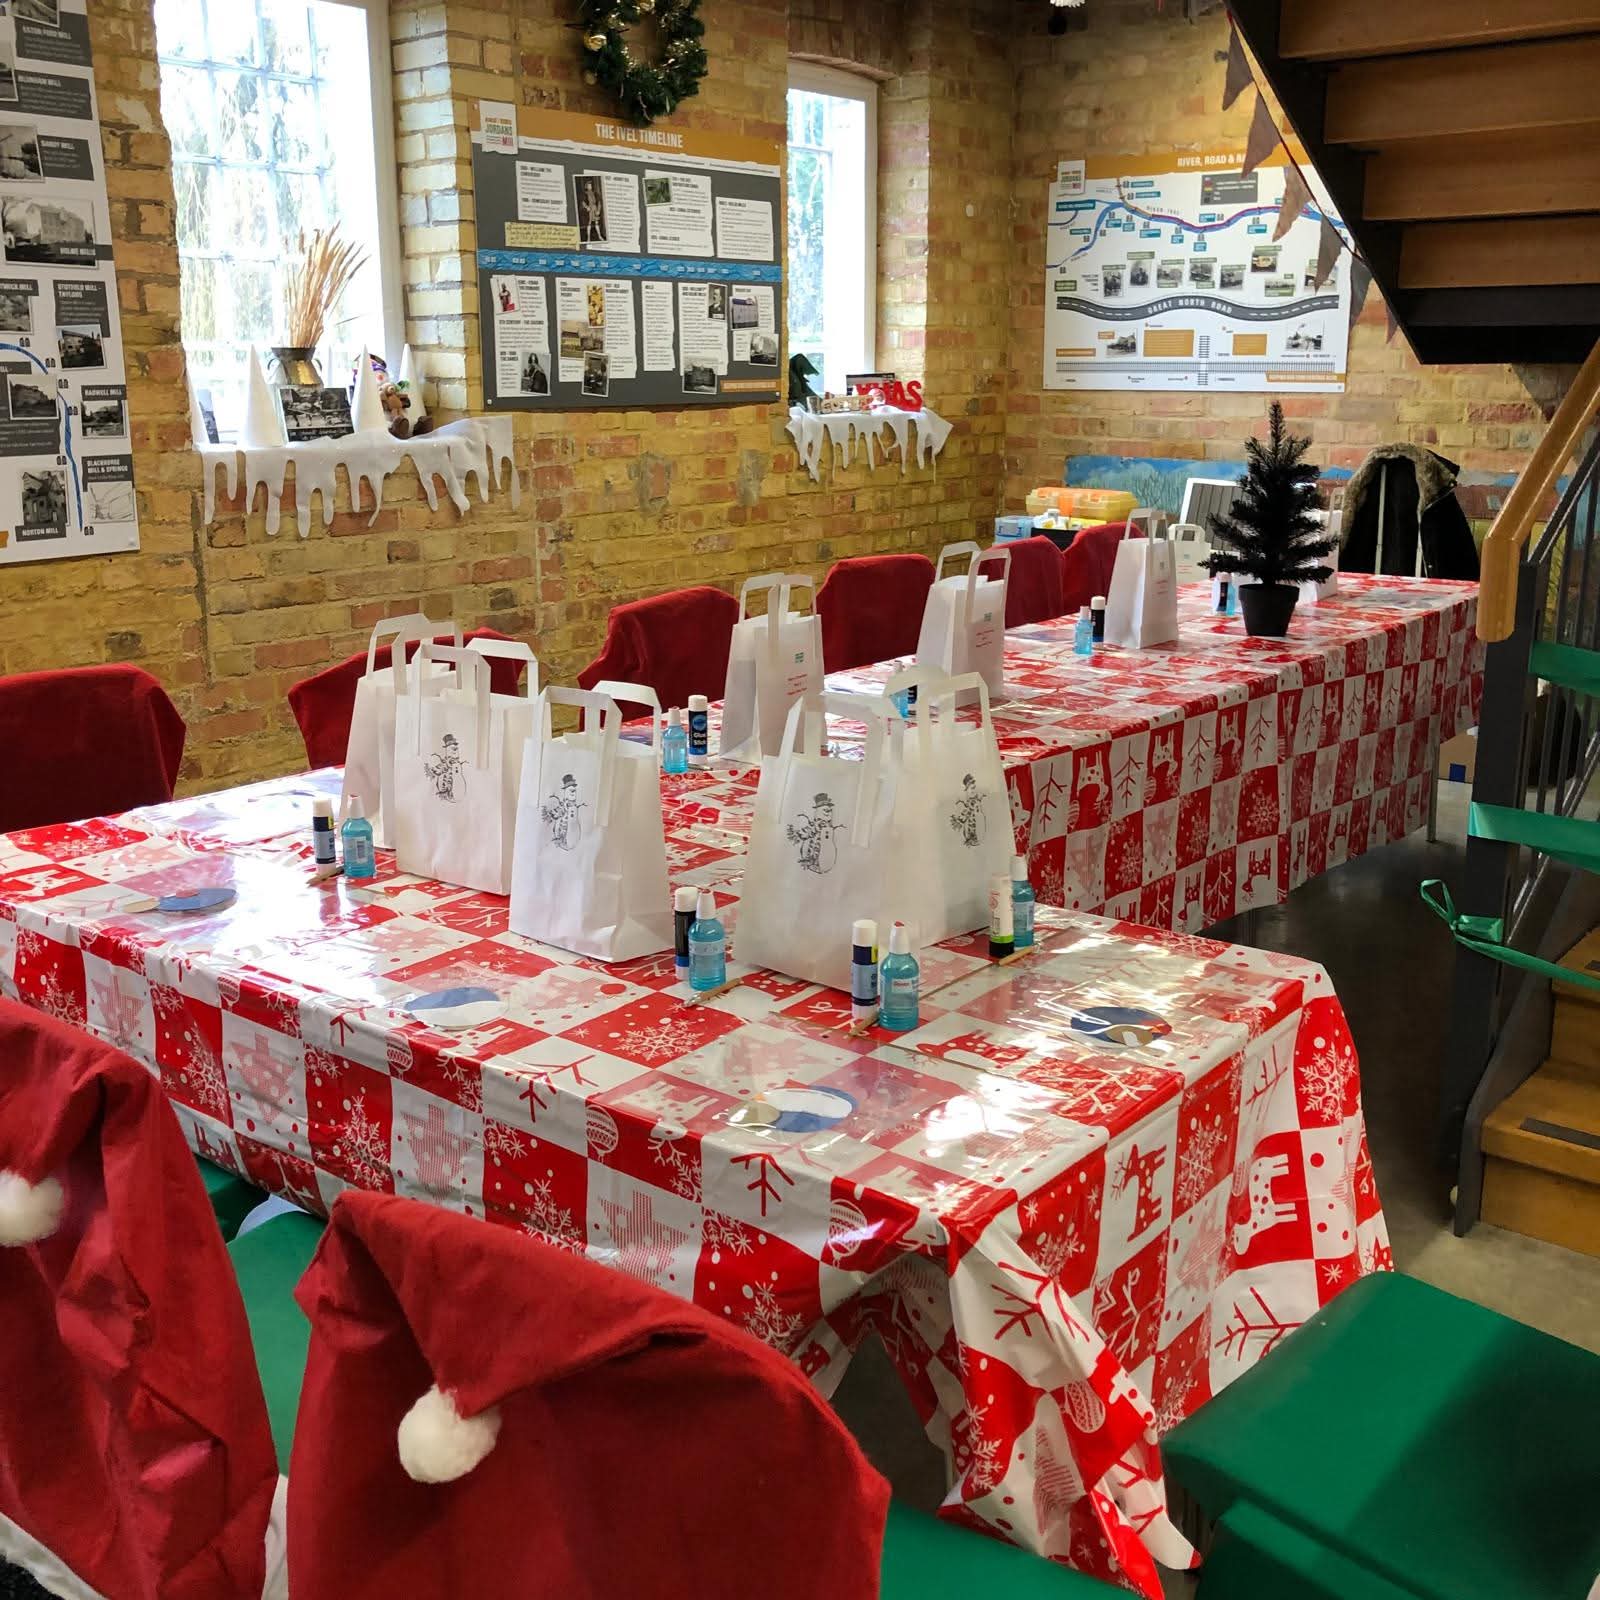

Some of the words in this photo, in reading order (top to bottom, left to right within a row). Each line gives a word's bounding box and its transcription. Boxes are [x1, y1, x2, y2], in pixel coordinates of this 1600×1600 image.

[595, 122, 615, 139] THE
[616, 126, 638, 142] IVEL
[639, 129, 683, 148] TIMELINE
[1177, 156, 1203, 168] RIVER,
[1204, 154, 1227, 165] ROAD
[1228, 153, 1235, 163] &
[1147, 300, 1172, 314] GREAT
[1178, 298, 1205, 306] NORTH
[1210, 301, 1233, 314] ROAD
